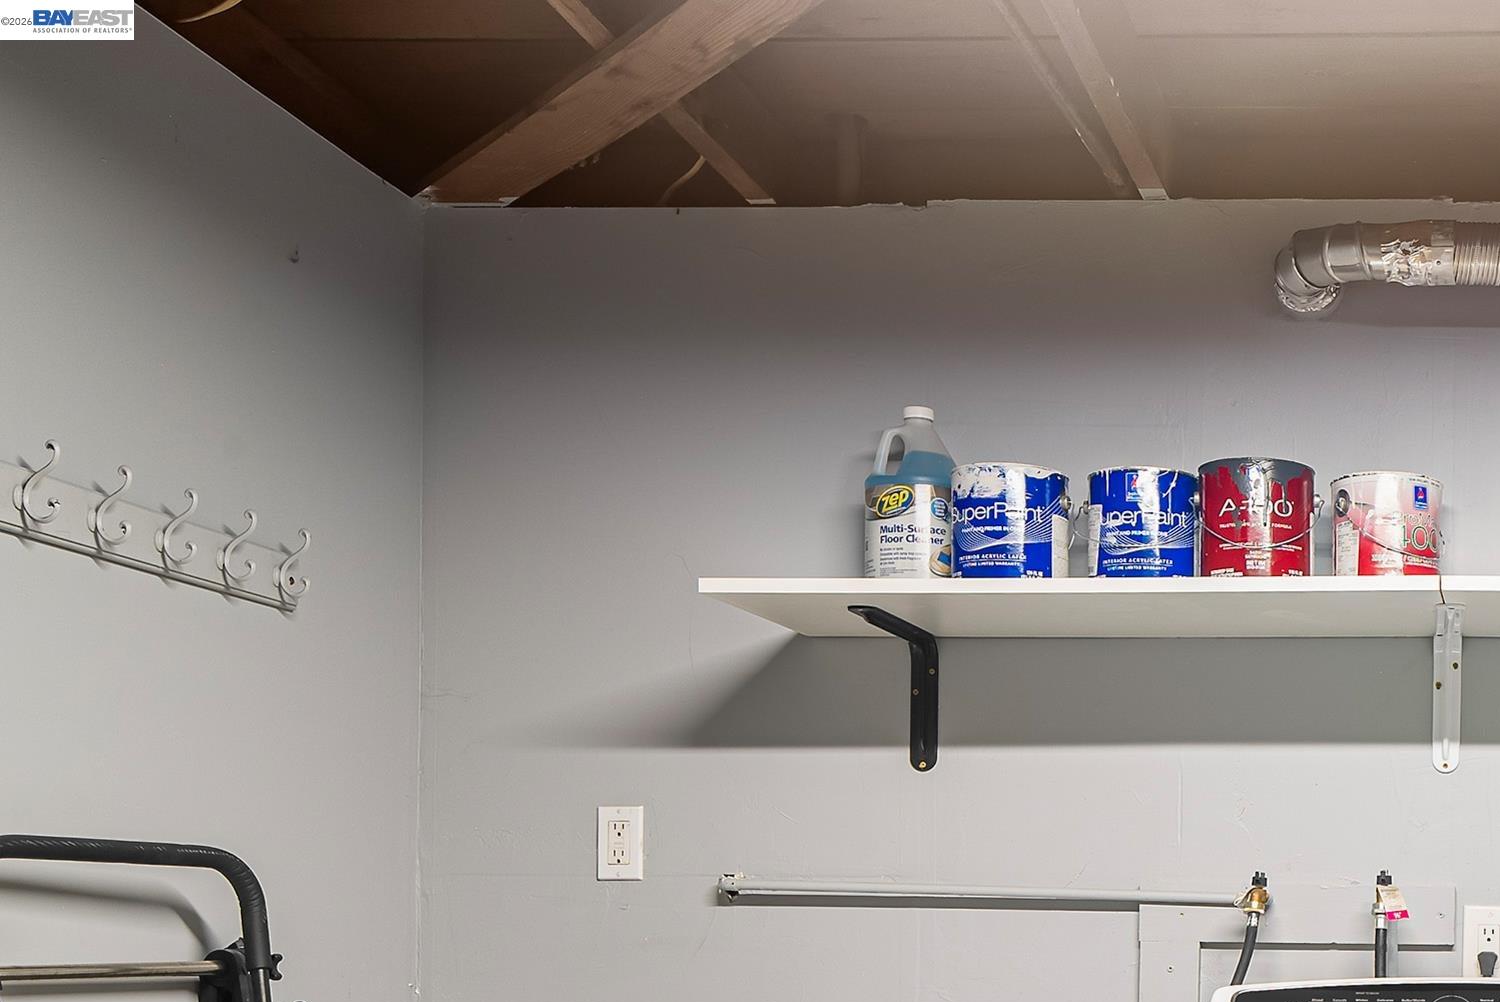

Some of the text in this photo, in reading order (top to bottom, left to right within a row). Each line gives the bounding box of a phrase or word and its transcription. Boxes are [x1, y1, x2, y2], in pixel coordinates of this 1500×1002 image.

[951, 502, 1045, 524] SuperPnt
[1101, 509, 1188, 528] uperaint
[880, 525, 947, 536] Multi-Surace
[880, 535, 904, 544] Floor
